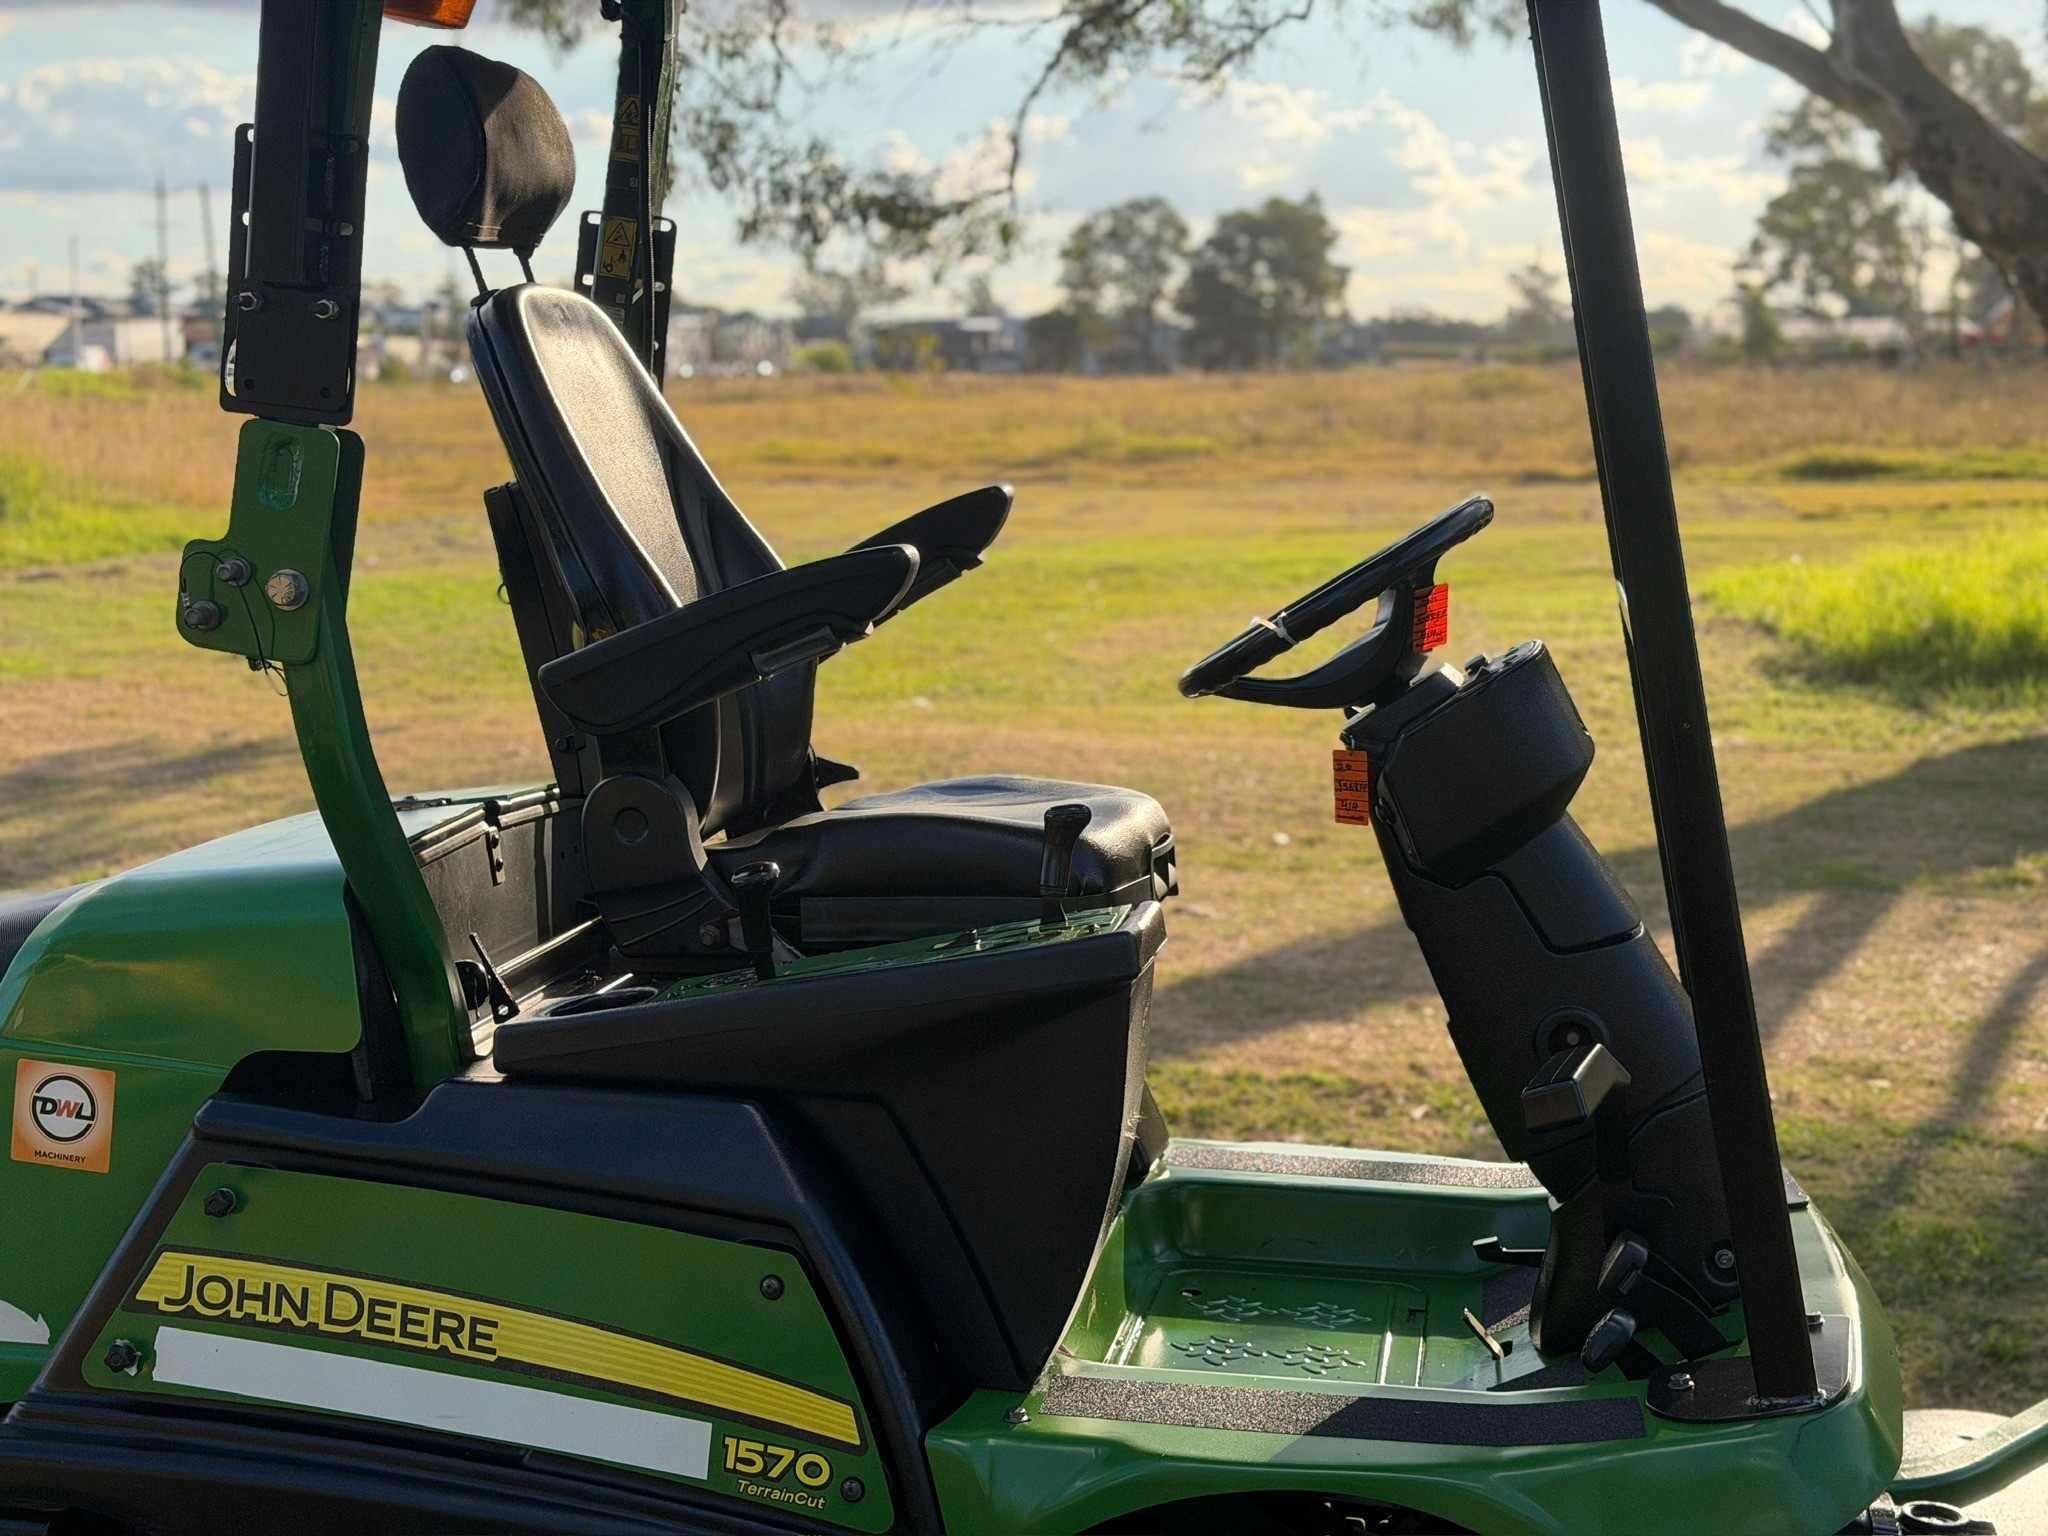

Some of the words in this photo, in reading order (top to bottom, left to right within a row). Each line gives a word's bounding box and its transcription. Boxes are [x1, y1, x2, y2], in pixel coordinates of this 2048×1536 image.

[33, 1095, 95, 1122] DWL
[34, 1149, 87, 1164] MACHINERY
[163, 1264, 310, 1323] JOHN
[323, 1282, 500, 1357] DEERE
[723, 1436, 831, 1487] 1570
[738, 1479, 827, 1510] TerrainCut
